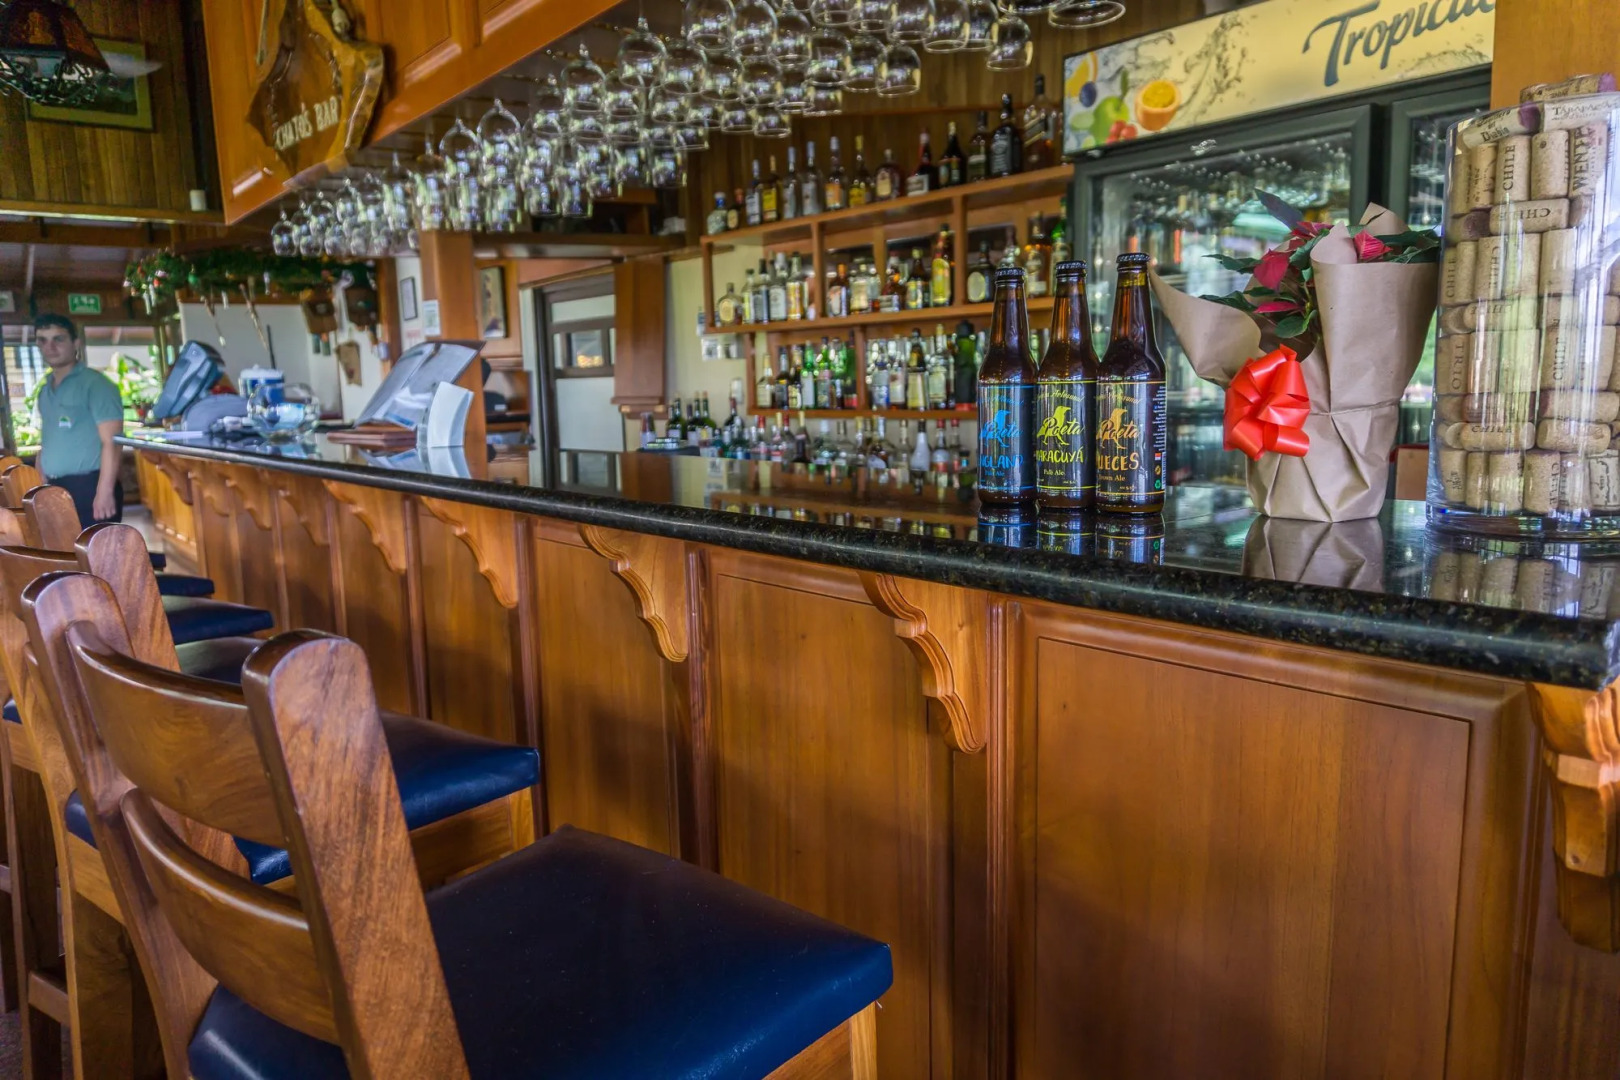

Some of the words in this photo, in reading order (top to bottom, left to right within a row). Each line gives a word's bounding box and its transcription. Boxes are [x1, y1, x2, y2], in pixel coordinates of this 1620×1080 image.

[313, 96, 339, 132] BAR
[1503, 145, 1515, 191] CHILE
[1452, 344, 1464, 390] TRIO
[1043, 416, 1085, 438] Poeta
[1099, 420, 1140, 441] Poeta
